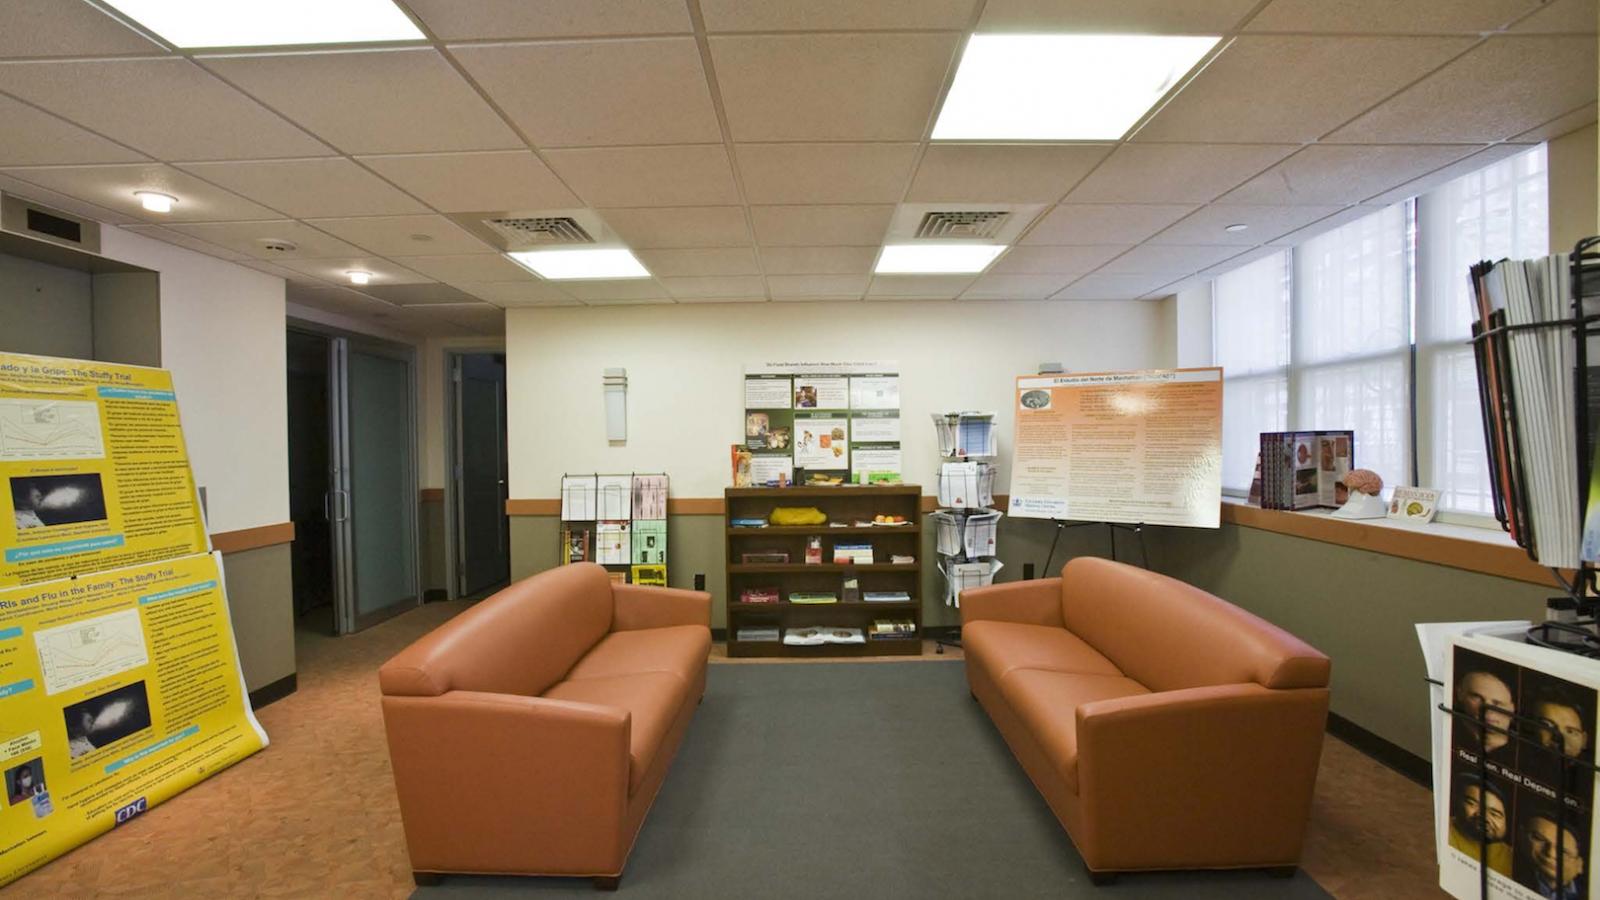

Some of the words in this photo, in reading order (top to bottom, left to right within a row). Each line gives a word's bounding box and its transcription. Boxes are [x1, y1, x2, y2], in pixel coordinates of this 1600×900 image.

[72, 368, 88, 377] The
[90, 370, 112, 380] Stuffy
[114, 372, 132, 380] Trial
[20, 594, 40, 606] and
[41, 591, 58, 603] Flu
[60, 588, 68, 598] in
[70, 586, 86, 596] the
[120, 576, 134, 586] The
[135, 572, 157, 584] Stuffy
[158, 568, 174, 578] Trial
[1460, 750, 1478, 764] Real
[1502, 768, 1522, 783] Real
[116, 798, 145, 822] CDC
